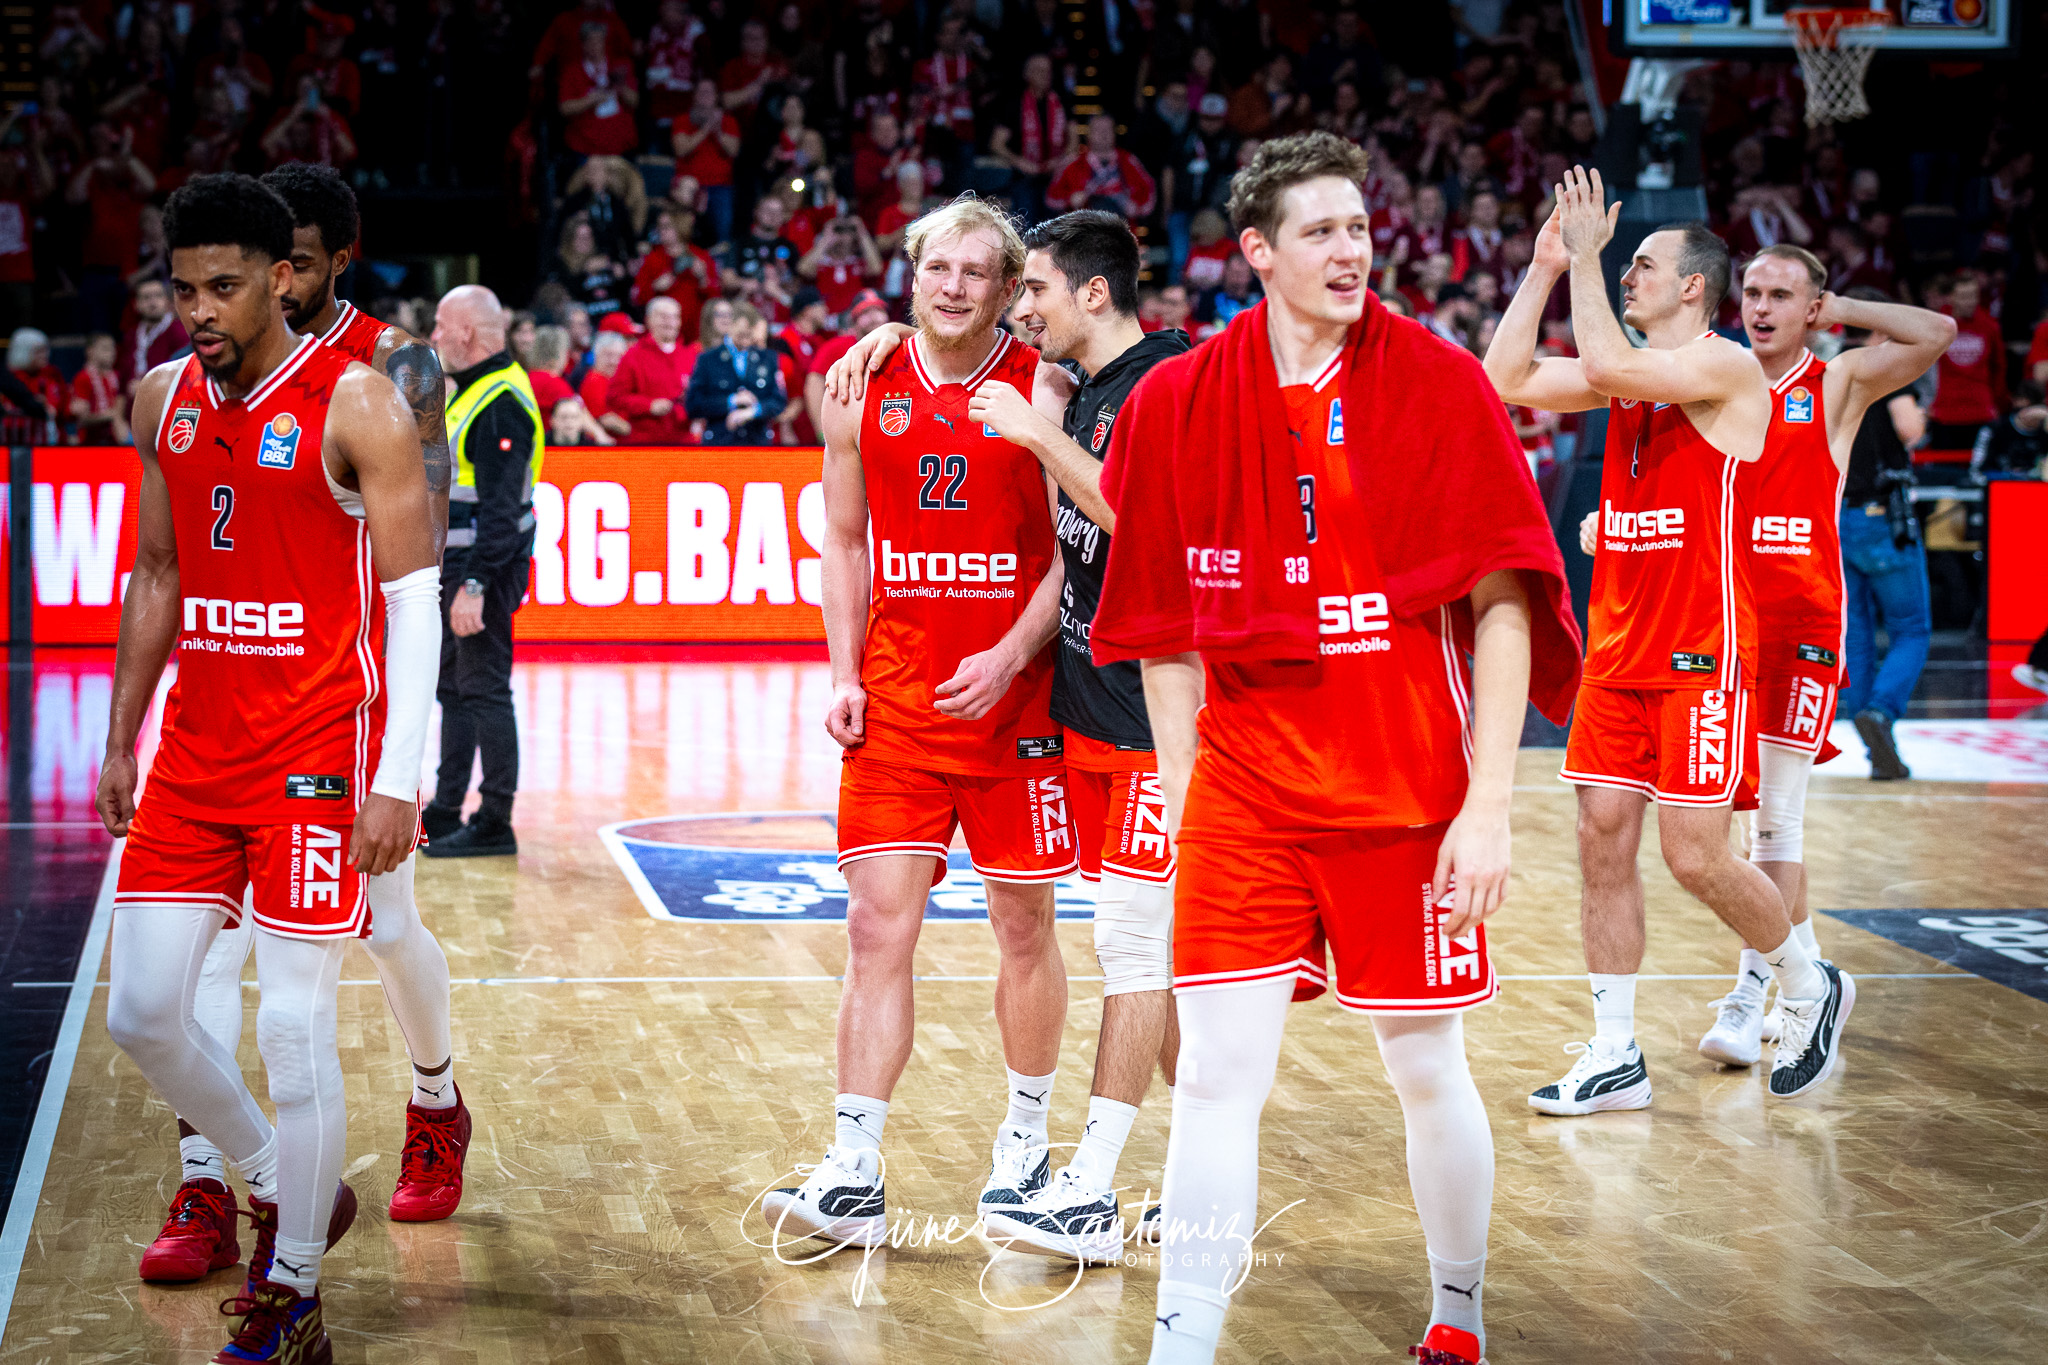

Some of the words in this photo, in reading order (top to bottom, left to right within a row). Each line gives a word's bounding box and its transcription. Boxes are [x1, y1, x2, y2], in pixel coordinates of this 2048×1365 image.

[262, 450, 290, 465] BBL
[918, 454, 967, 510] 22
[211, 485, 234, 551] 2
[1604, 499, 1685, 538] brose
[882, 540, 1017, 582] brose
[1631, 538, 1684, 553] Autmobile
[1284, 556, 1310, 584] 33
[945, 587, 1015, 599] Automobile
[184, 597, 304, 637] rose
[1318, 592, 1389, 634] se
[182, 638, 205, 650] nik
[206, 639, 222, 652] für
[225, 641, 304, 656] Automobile
[1698, 656, 1704, 665] L
[1689, 706, 1698, 738] STIRKAT
[1047, 739, 1057, 749] XL
[1688, 745, 1697, 784] KOLLEGEN
[325, 778, 333, 790] L
[1028, 778, 1037, 803] IRKAT
[1032, 812, 1044, 856] KOLLEGEN
[1120, 809, 1133, 854] KOLLEGEN
[291, 847, 301, 855] &
[290, 856, 300, 908] KOLLEGEN
[1422, 882, 1434, 924] STIRKAT
[1423, 926, 1434, 934] &
[1424, 935, 1437, 986] KOLLEGEN
